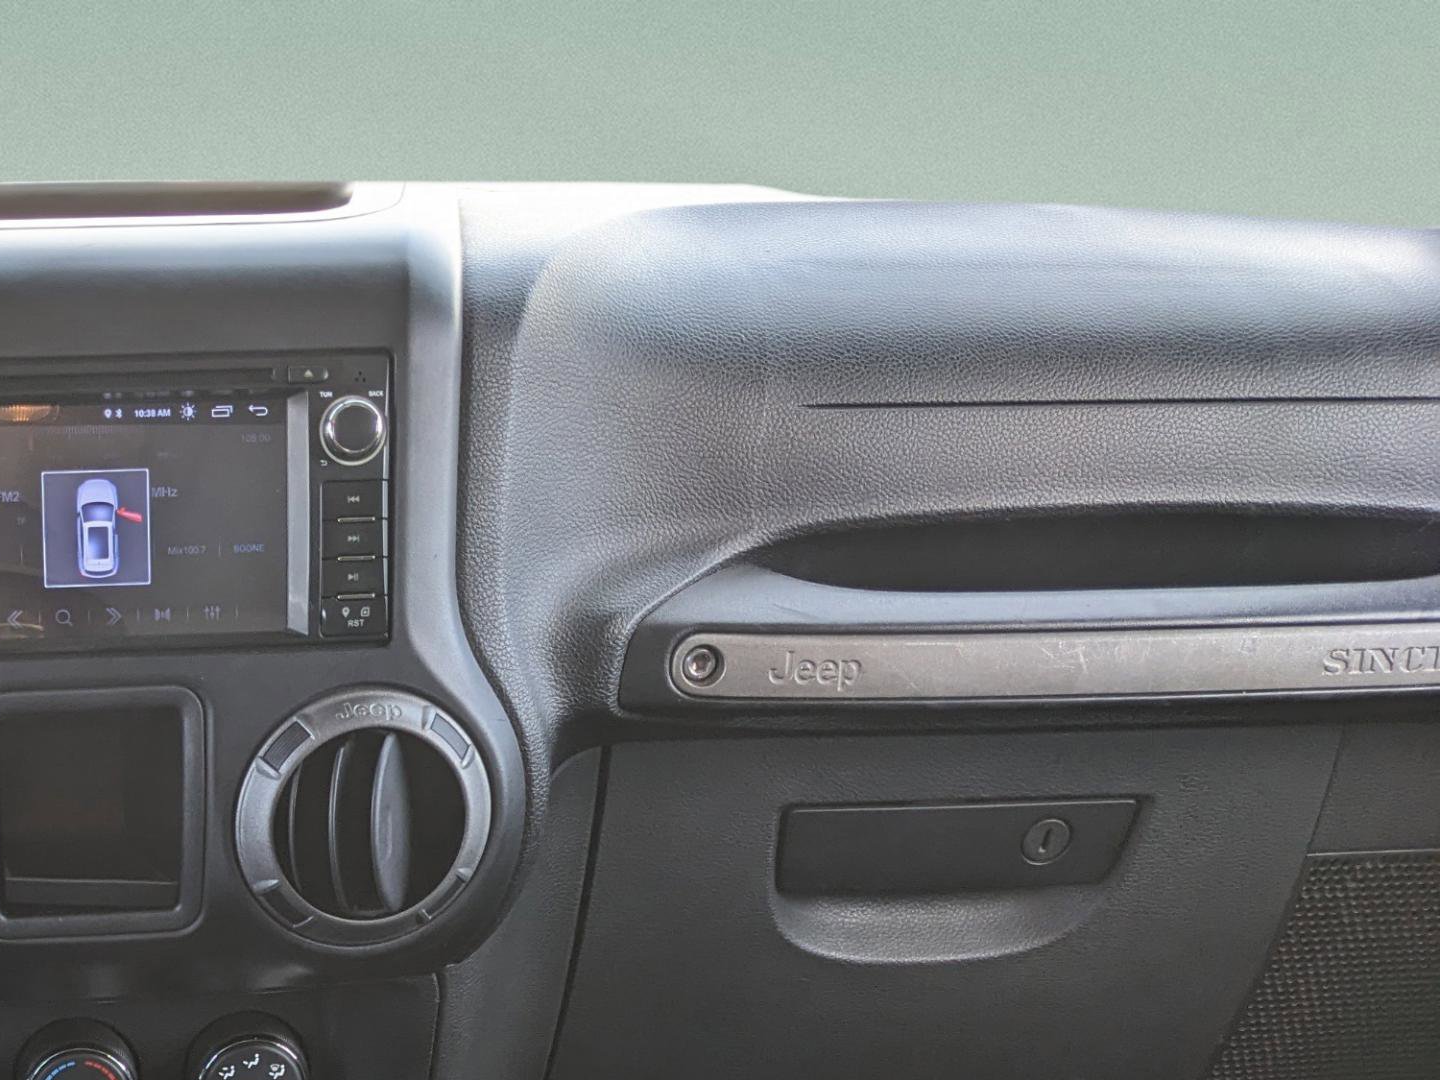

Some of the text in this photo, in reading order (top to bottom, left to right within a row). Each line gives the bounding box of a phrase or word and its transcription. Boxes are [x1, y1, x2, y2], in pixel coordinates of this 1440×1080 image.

[157, 408, 171, 417] AM
[151, 487, 178, 498] MHz
[347, 619, 364, 627] RST
[768, 651, 862, 693] Jeep
[335, 703, 402, 721] Jeep
